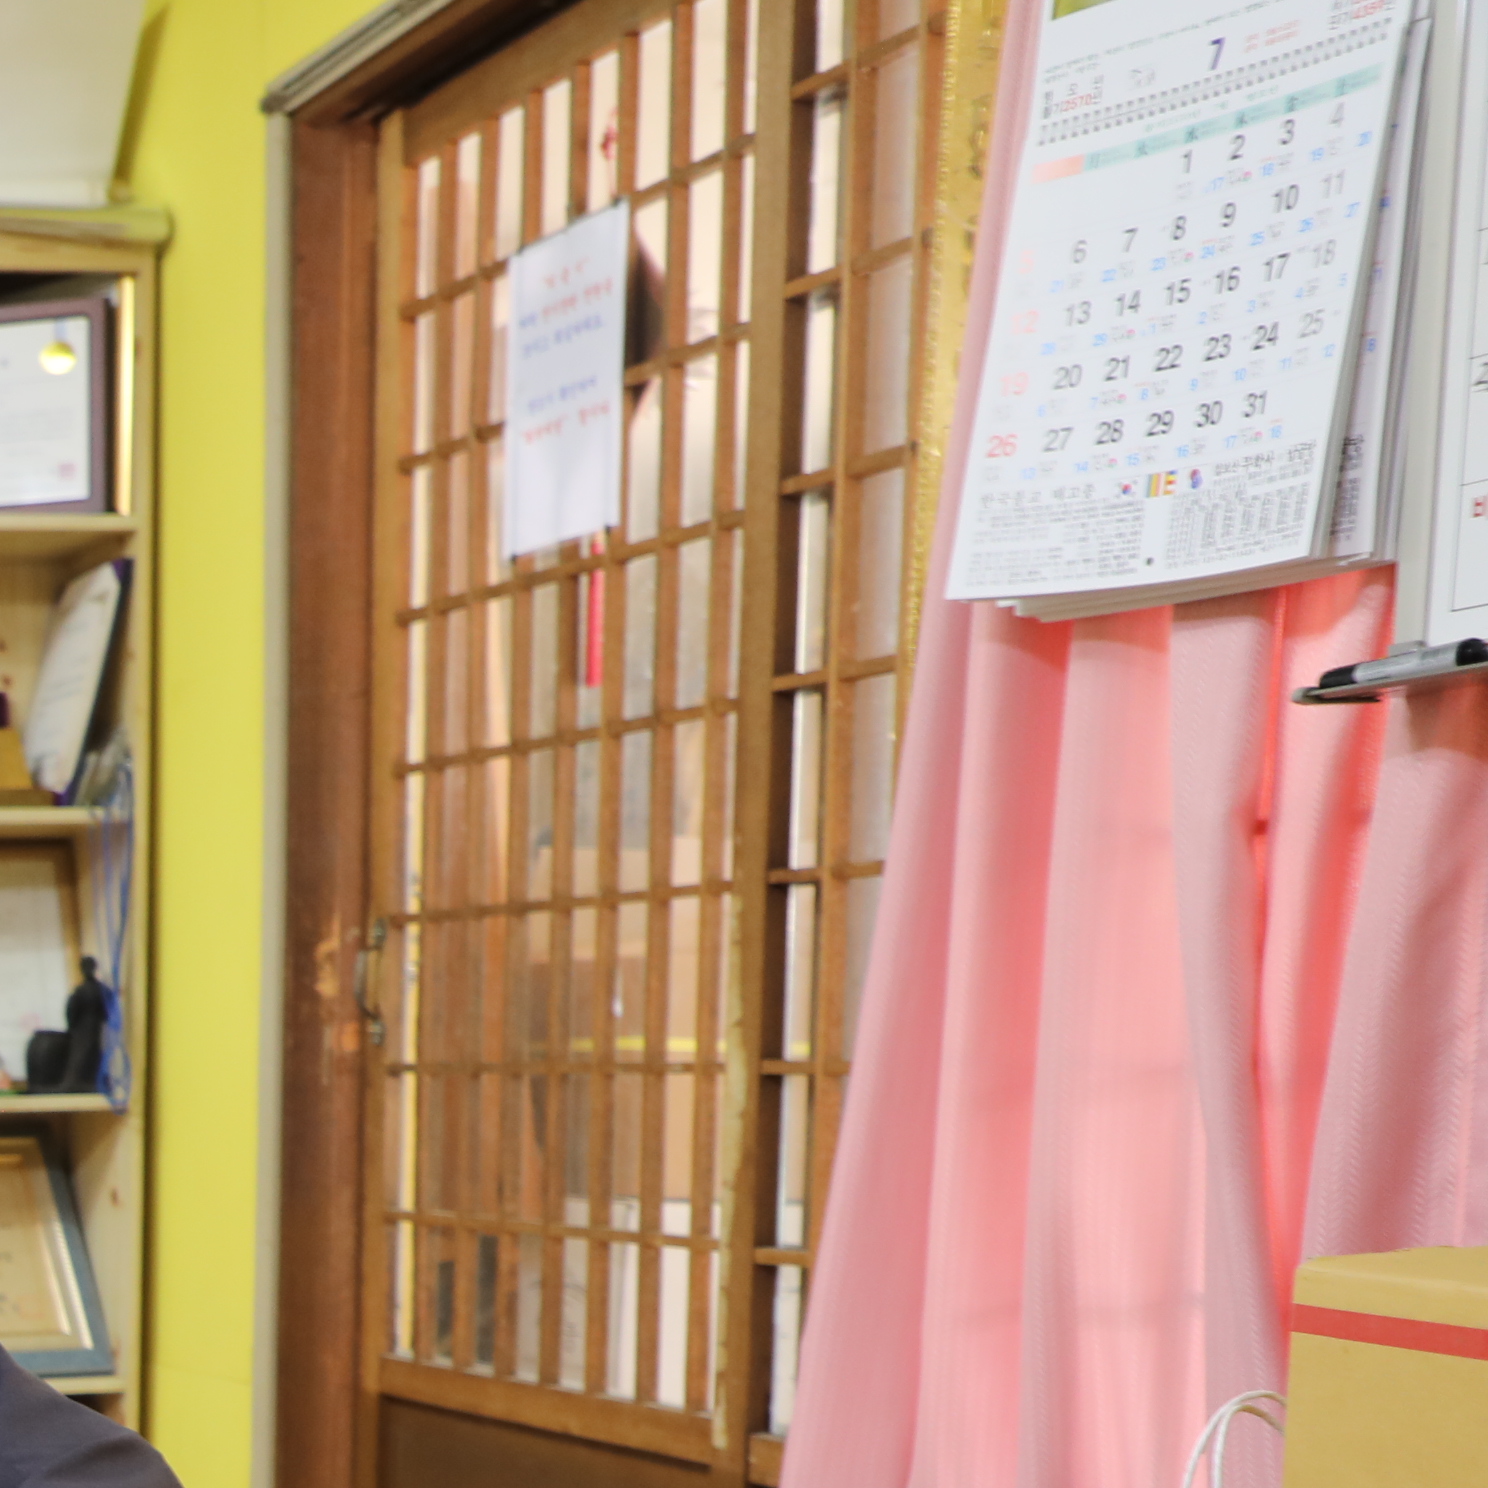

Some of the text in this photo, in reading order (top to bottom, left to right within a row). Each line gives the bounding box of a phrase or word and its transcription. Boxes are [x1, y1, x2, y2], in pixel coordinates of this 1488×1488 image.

[1209, 37, 1225, 70] 7
[1182, 149, 1193, 174] 1
[1230, 134, 1246, 161] 2
[1280, 118, 1295, 146] 3
[1073, 239, 1088, 264] 6
[1123, 227, 1138, 252] 7
[1172, 215, 1187, 241] 8
[1221, 202, 1237, 228] 9
[1272, 184, 1299, 213] 10
[1065, 301, 1092, 326] 13
[1115, 289, 1141, 317] 14
[1164, 278, 1192, 306] 15
[1215, 266, 1241, 295] 16
[1263, 252, 1291, 282] 17
[1052, 364, 1083, 390] 20
[1104, 355, 1130, 382] 21
[1154, 344, 1183, 372] 22
[1202, 333, 1232, 362] 23
[1253, 321, 1279, 350] 24
[1299, 308, 1325, 338] 25
[986, 389, 1268, 459] 26 27 28 29 30 31
